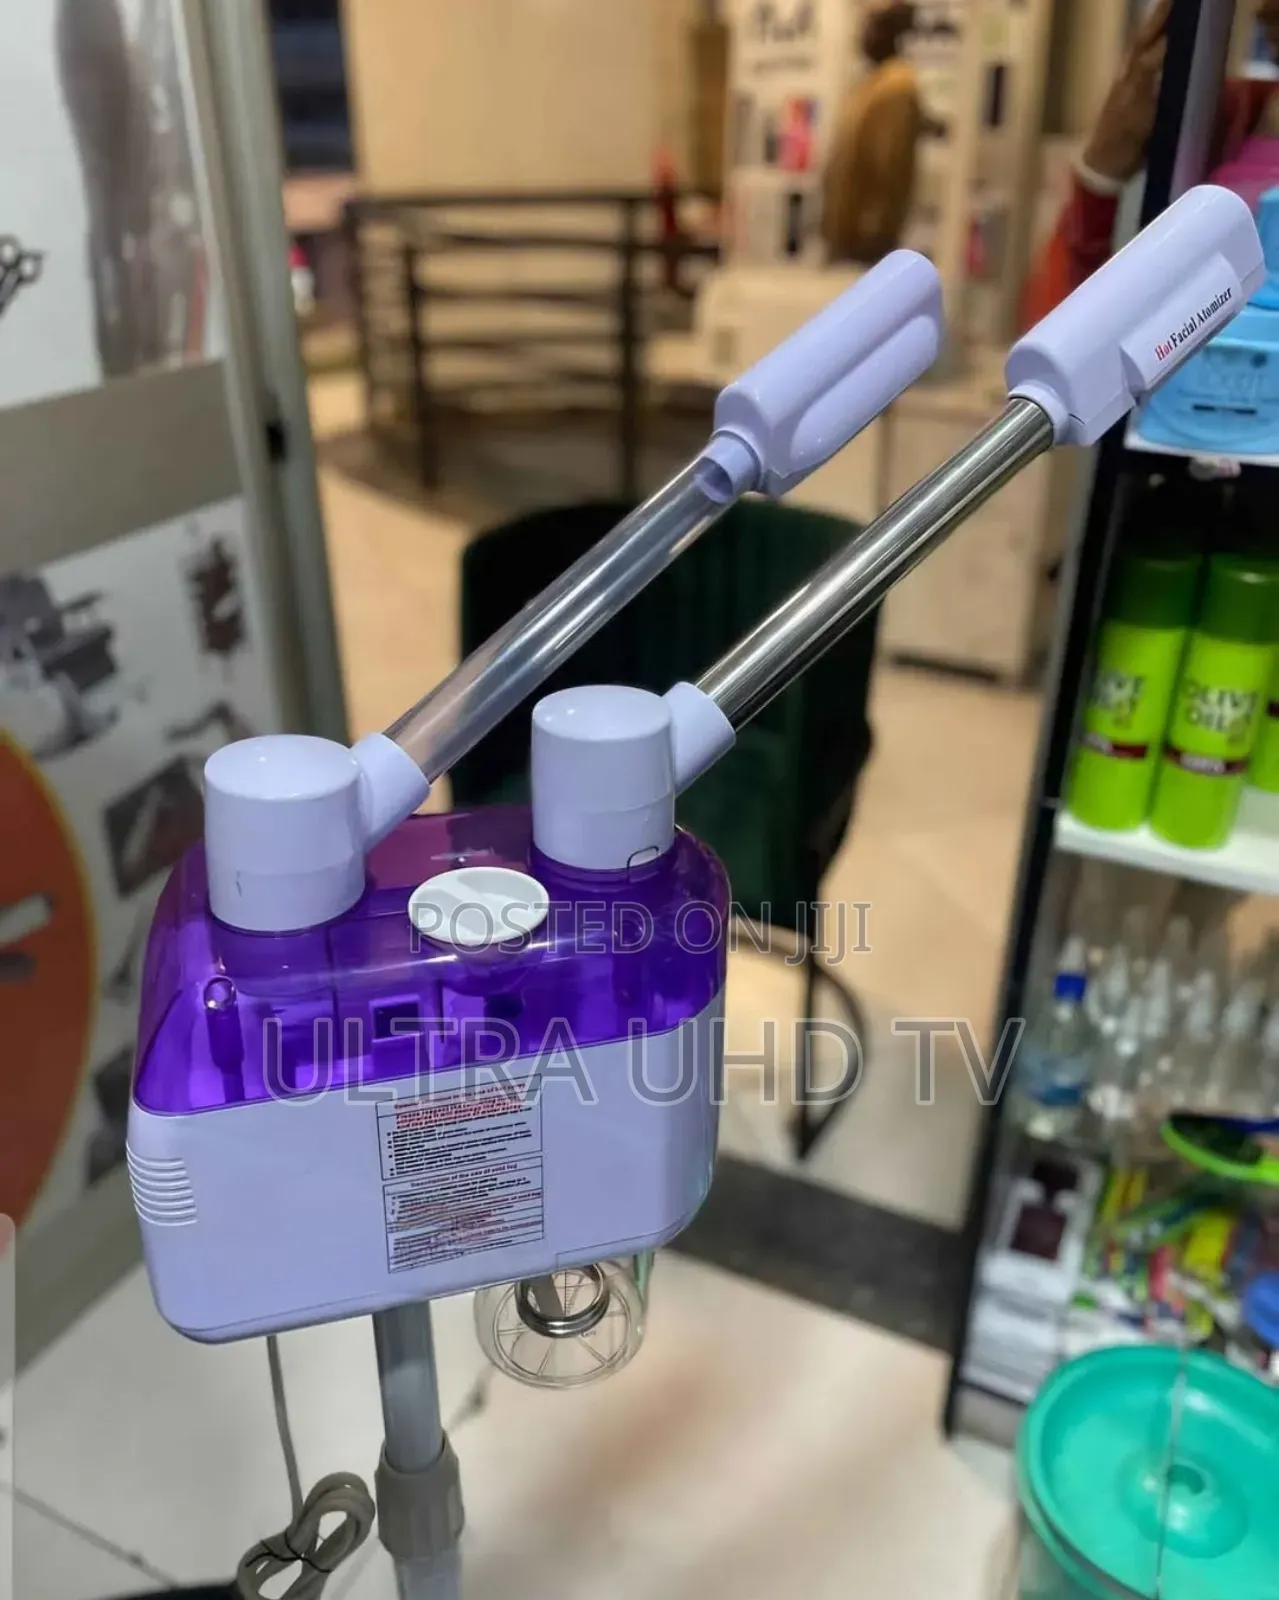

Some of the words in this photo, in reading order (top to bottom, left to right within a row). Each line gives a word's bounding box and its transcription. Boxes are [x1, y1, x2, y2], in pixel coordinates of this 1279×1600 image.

[1155, 341, 1173, 361] Hot
[1169, 316, 1198, 348] Facial
[1196, 287, 1232, 326] Atomizer
